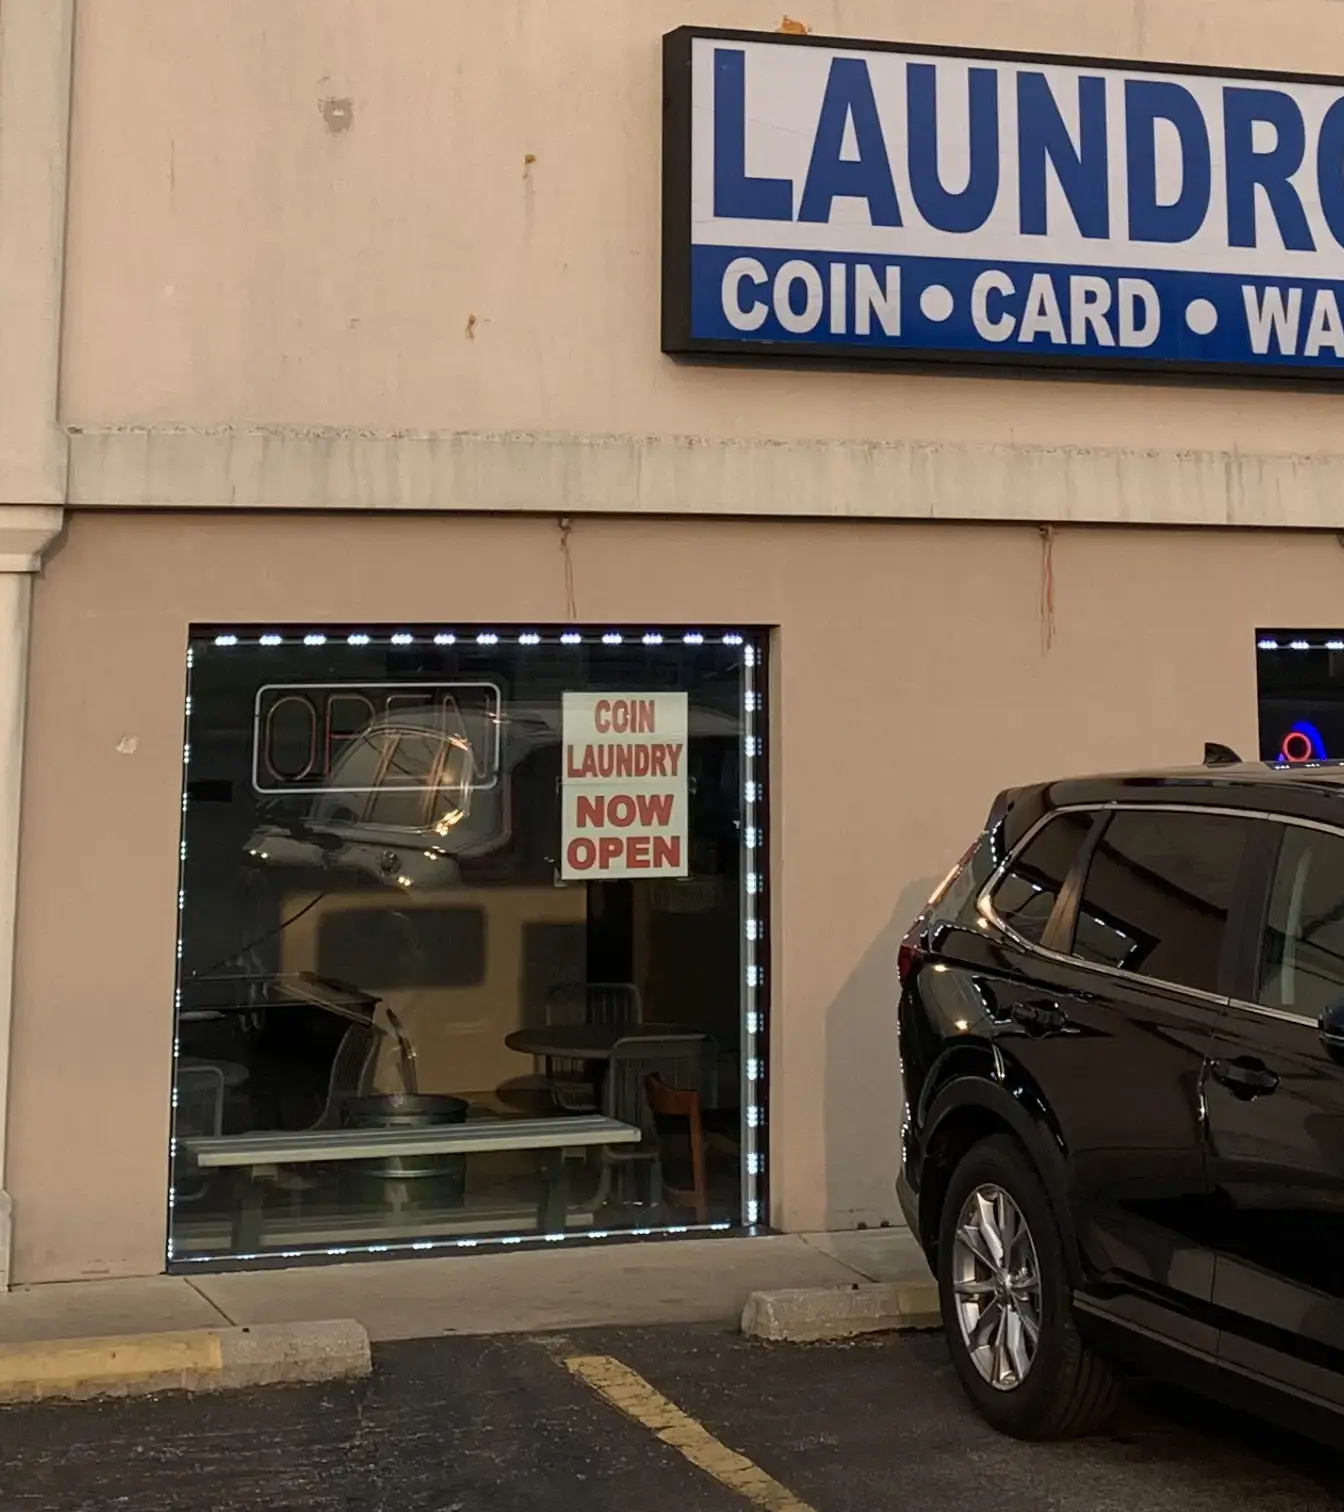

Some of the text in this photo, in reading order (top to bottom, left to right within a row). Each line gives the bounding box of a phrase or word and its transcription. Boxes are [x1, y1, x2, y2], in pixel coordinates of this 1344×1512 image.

[720, 256, 902, 337] COIN
[970, 269, 1161, 349] CARD
[594, 699, 656, 734] COIN
[264, 692, 492, 782] OPEN
[566, 743, 684, 779] LAUNDRY
[576, 794, 675, 829] NOW
[566, 835, 681, 871] OPEN
